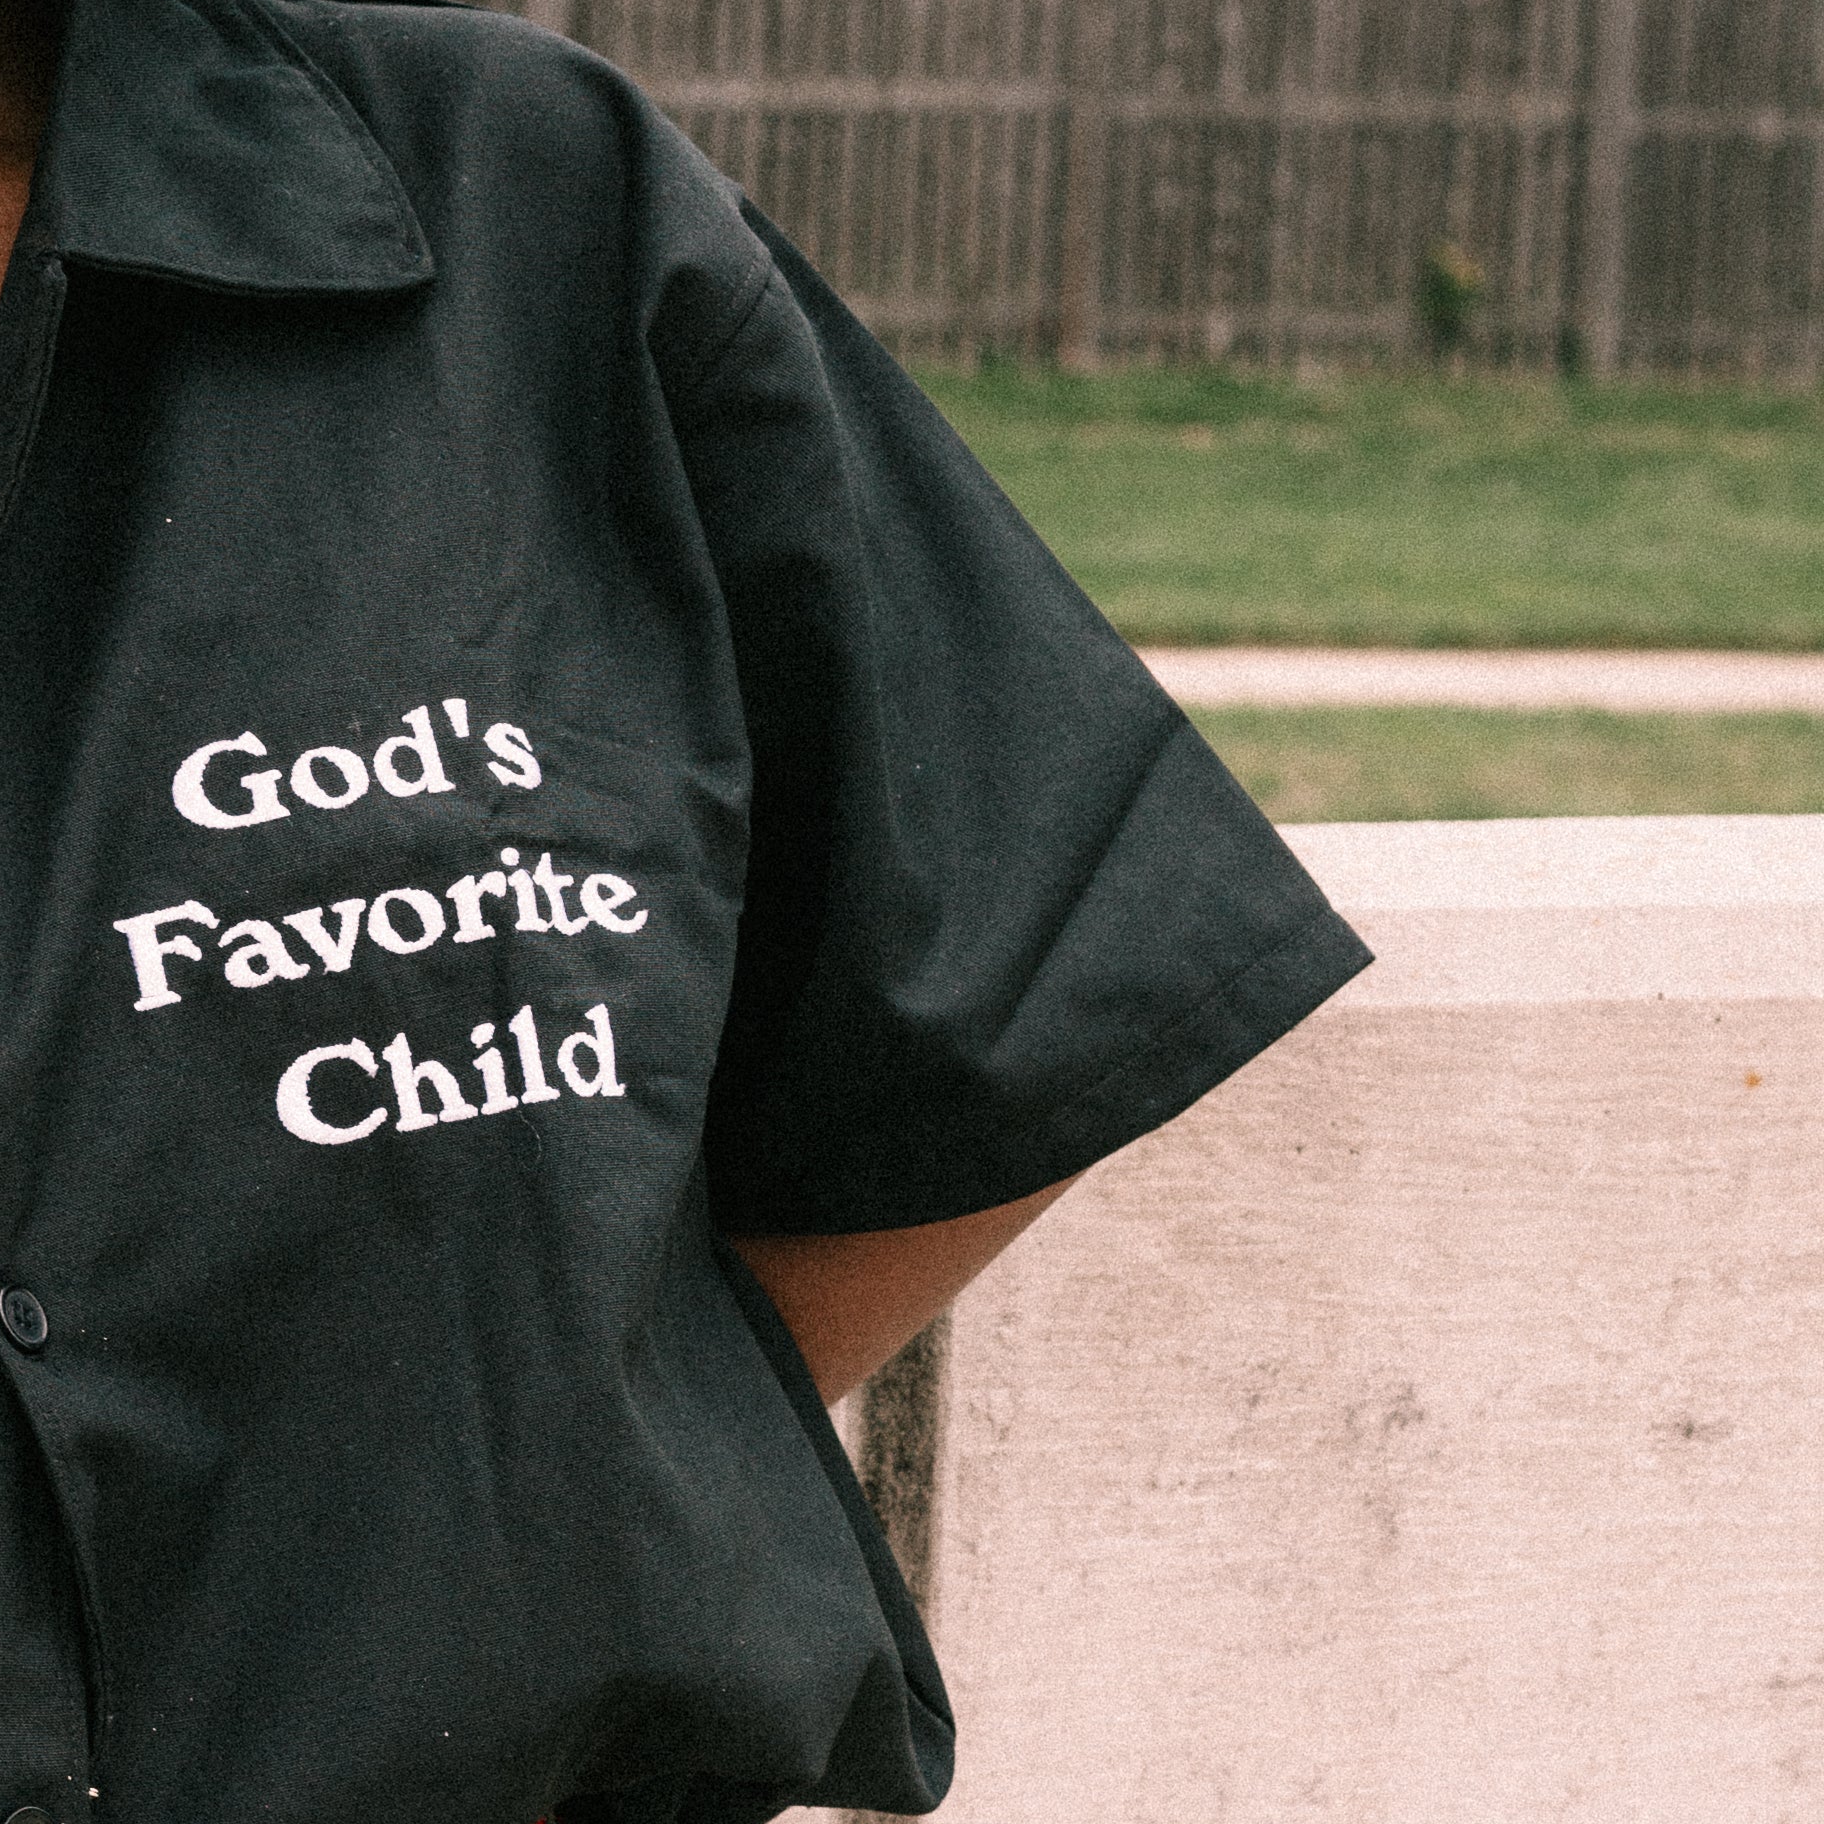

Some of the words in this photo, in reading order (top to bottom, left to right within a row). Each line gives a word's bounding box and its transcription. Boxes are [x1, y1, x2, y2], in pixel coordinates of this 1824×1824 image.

[172, 698, 542, 830] God's
[113, 847, 648, 1011] Favorite
[276, 1003, 626, 1145] Child
